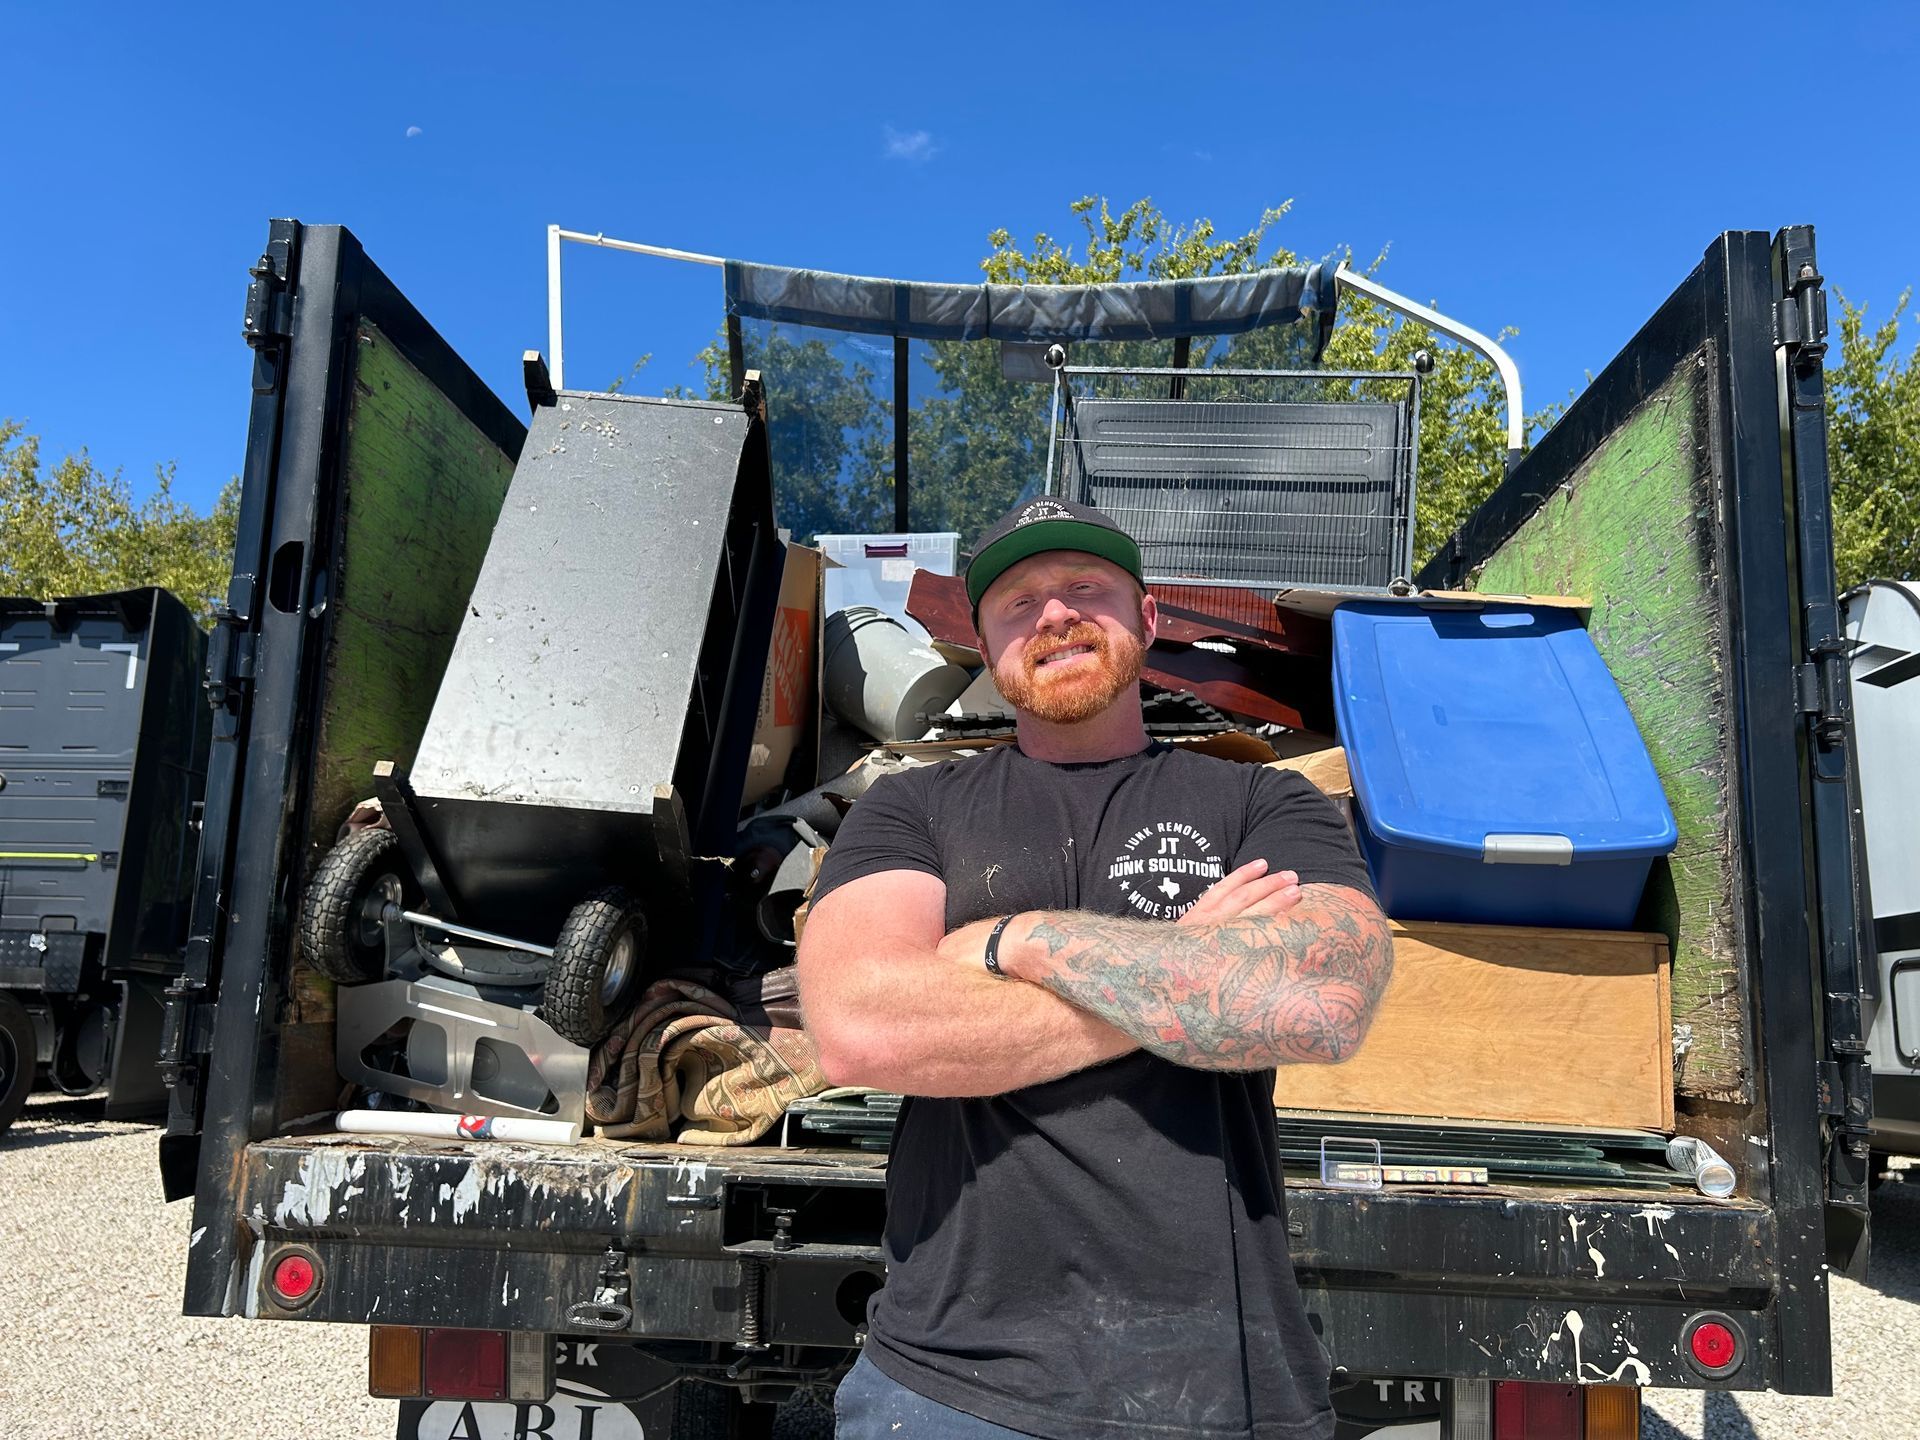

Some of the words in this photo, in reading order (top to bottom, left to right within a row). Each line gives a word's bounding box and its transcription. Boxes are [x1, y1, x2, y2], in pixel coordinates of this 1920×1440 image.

[1038, 507, 1049, 517] JT
[764, 665, 772, 714] doers
[1124, 826, 1154, 851] JUNK
[1156, 821, 1212, 853] REMOVAL
[1157, 837, 1180, 855] JT
[1108, 859, 1145, 880] JUNK
[1127, 889, 1161, 917] MADE
[1164, 893, 1203, 919] SIMP
